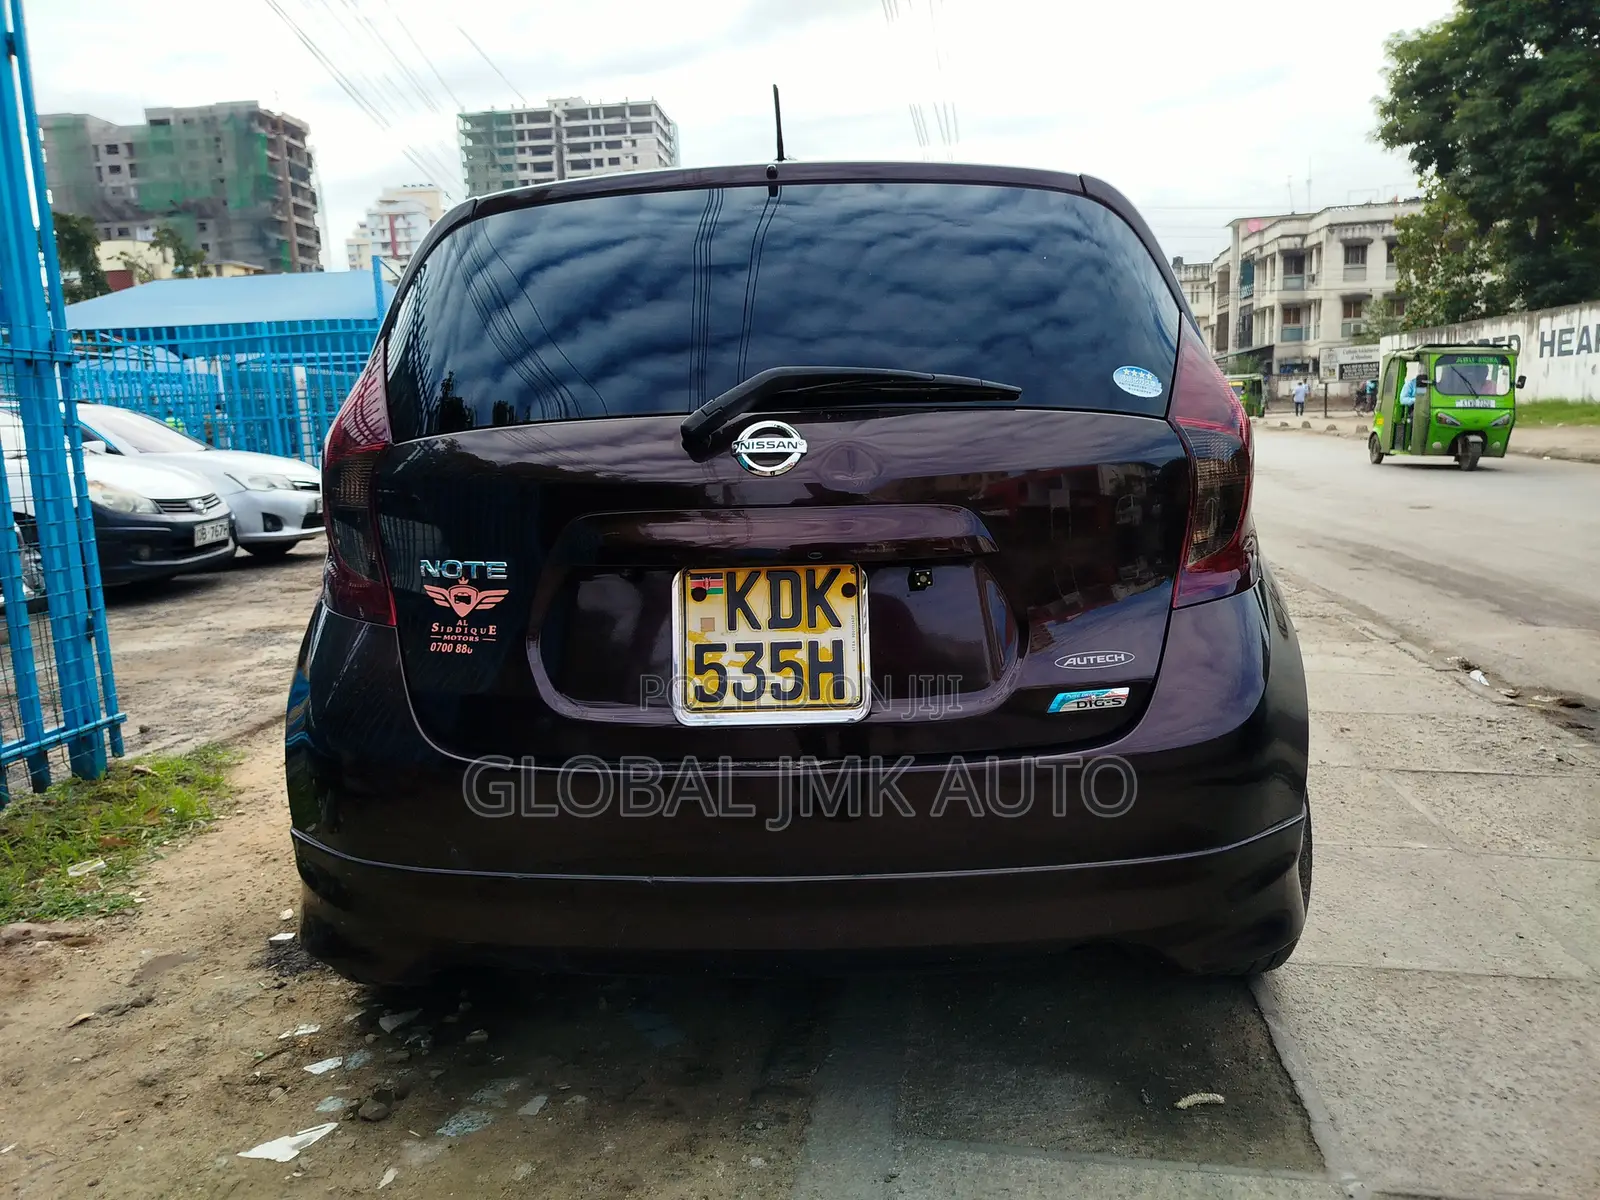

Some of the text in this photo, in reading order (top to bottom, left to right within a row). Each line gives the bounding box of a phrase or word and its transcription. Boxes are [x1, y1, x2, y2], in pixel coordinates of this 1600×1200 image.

[1539, 324, 1600, 358] HEA
[740, 440, 798, 450] NISSAN
[420, 559, 508, 579] NOTE
[726, 568, 842, 631] KDK
[431, 622, 497, 635] SIDDIQUE
[430, 642, 453, 653] 0700
[1063, 653, 1125, 666] AUTECH
[694, 639, 846, 703] 535H
[1076, 698, 1122, 708] DIG-S
